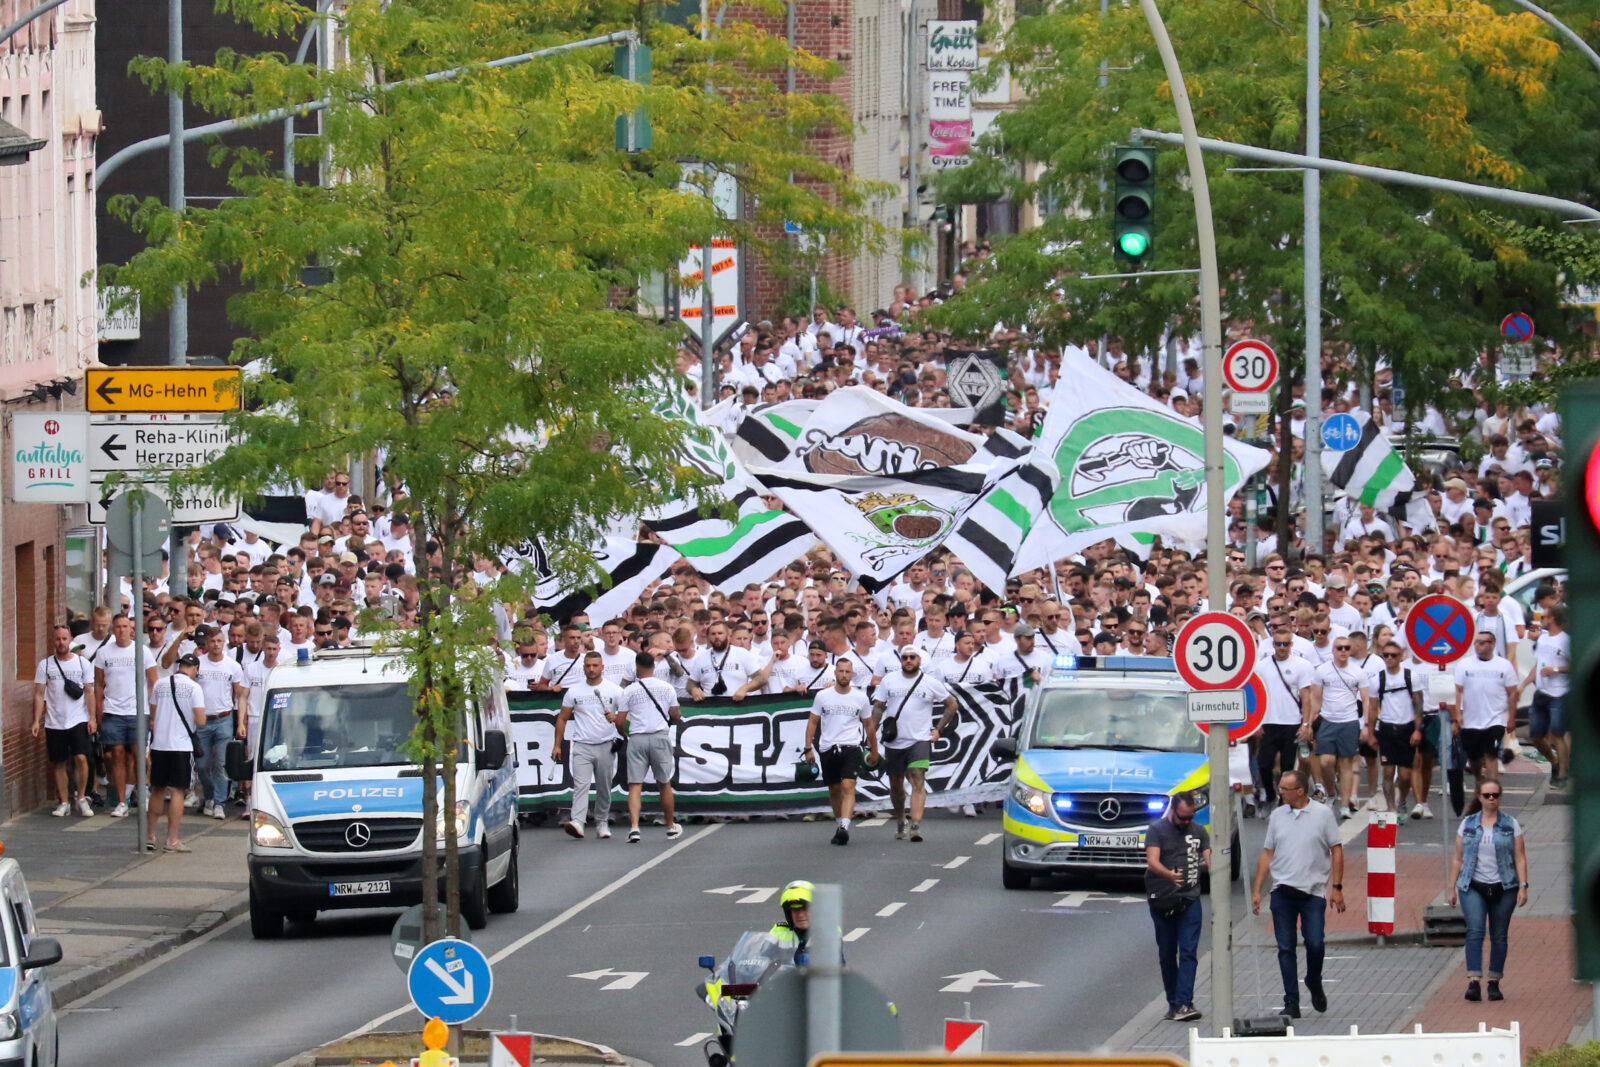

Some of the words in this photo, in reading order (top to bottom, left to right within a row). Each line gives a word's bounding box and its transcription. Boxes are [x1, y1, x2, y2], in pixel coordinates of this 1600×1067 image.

[932, 81, 967, 92] FREE
[934, 97, 966, 108] TIME
[932, 155, 969, 168] Gyros
[1235, 356, 1265, 379] 30
[129, 384, 207, 397] MG-Hehn
[136, 430, 234, 444] Reha-Klinik
[16, 441, 83, 468] antalya
[136, 450, 213, 467] Herzpark
[28, 468, 71, 479] GRILL
[1192, 635, 1237, 672] 30
[1191, 701, 1240, 712] Lärmschutz
[1068, 766, 1153, 777] POLIZEI
[313, 787, 404, 800] POLIZEI
[1085, 836, 1101, 846] NRW
[335, 884, 352, 894] NRW
